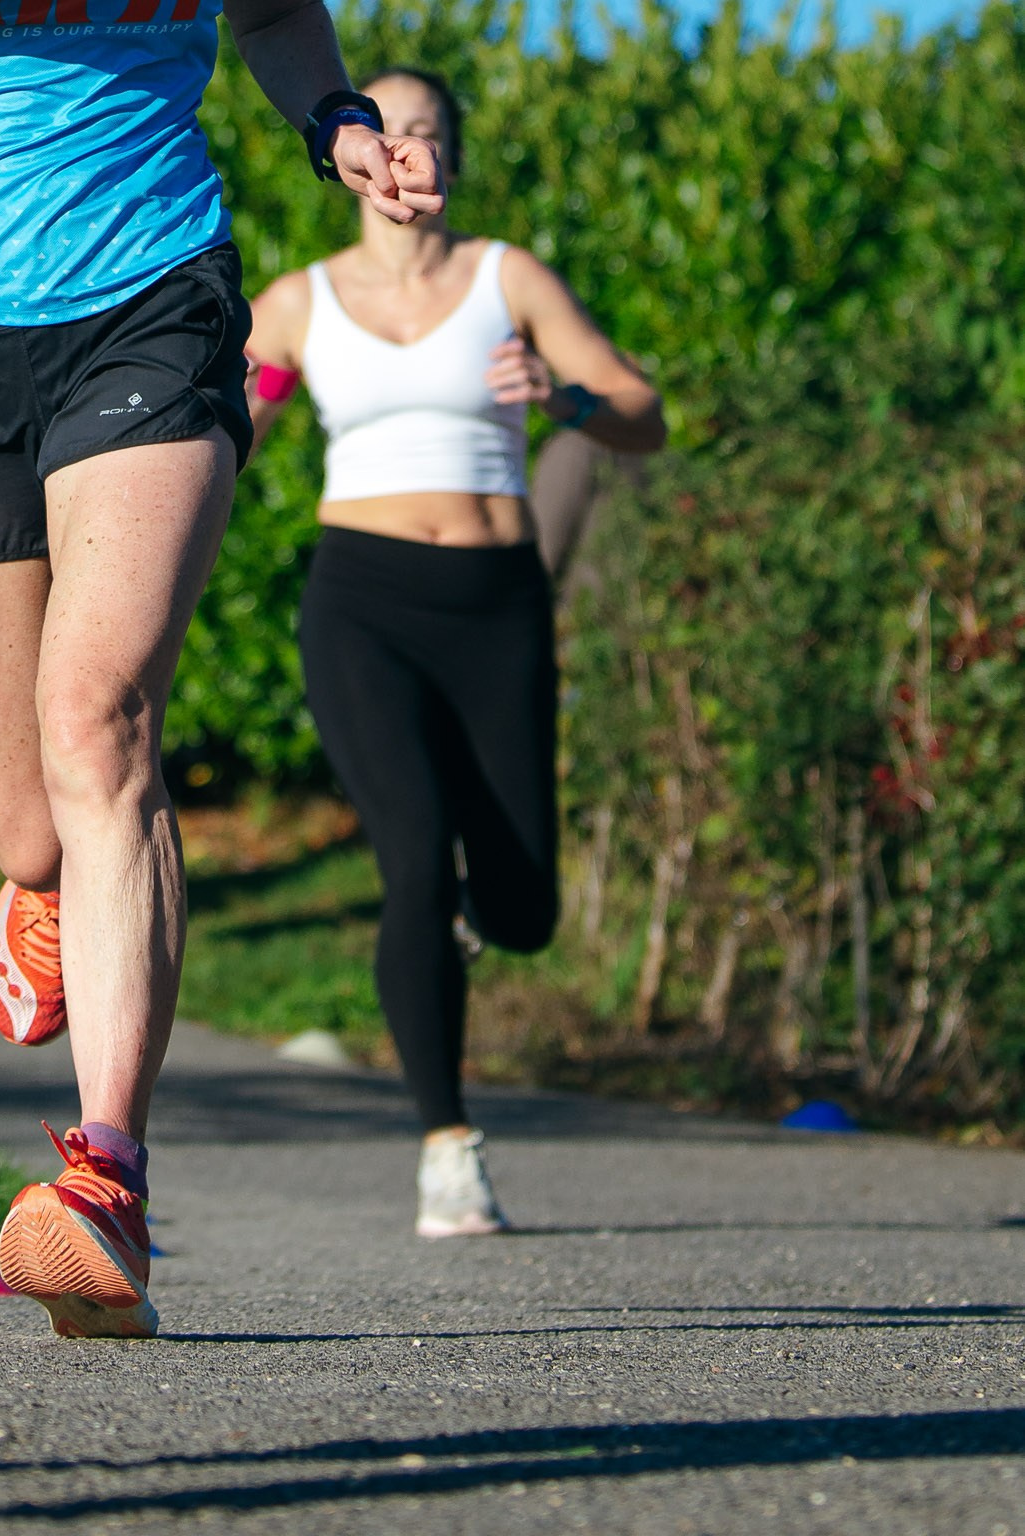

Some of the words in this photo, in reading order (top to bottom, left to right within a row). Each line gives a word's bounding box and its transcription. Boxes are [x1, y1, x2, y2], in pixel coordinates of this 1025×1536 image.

[22, 26, 43, 37] IS
[53, 25, 95, 36] OUR
[105, 23, 194, 35] THERAPY
